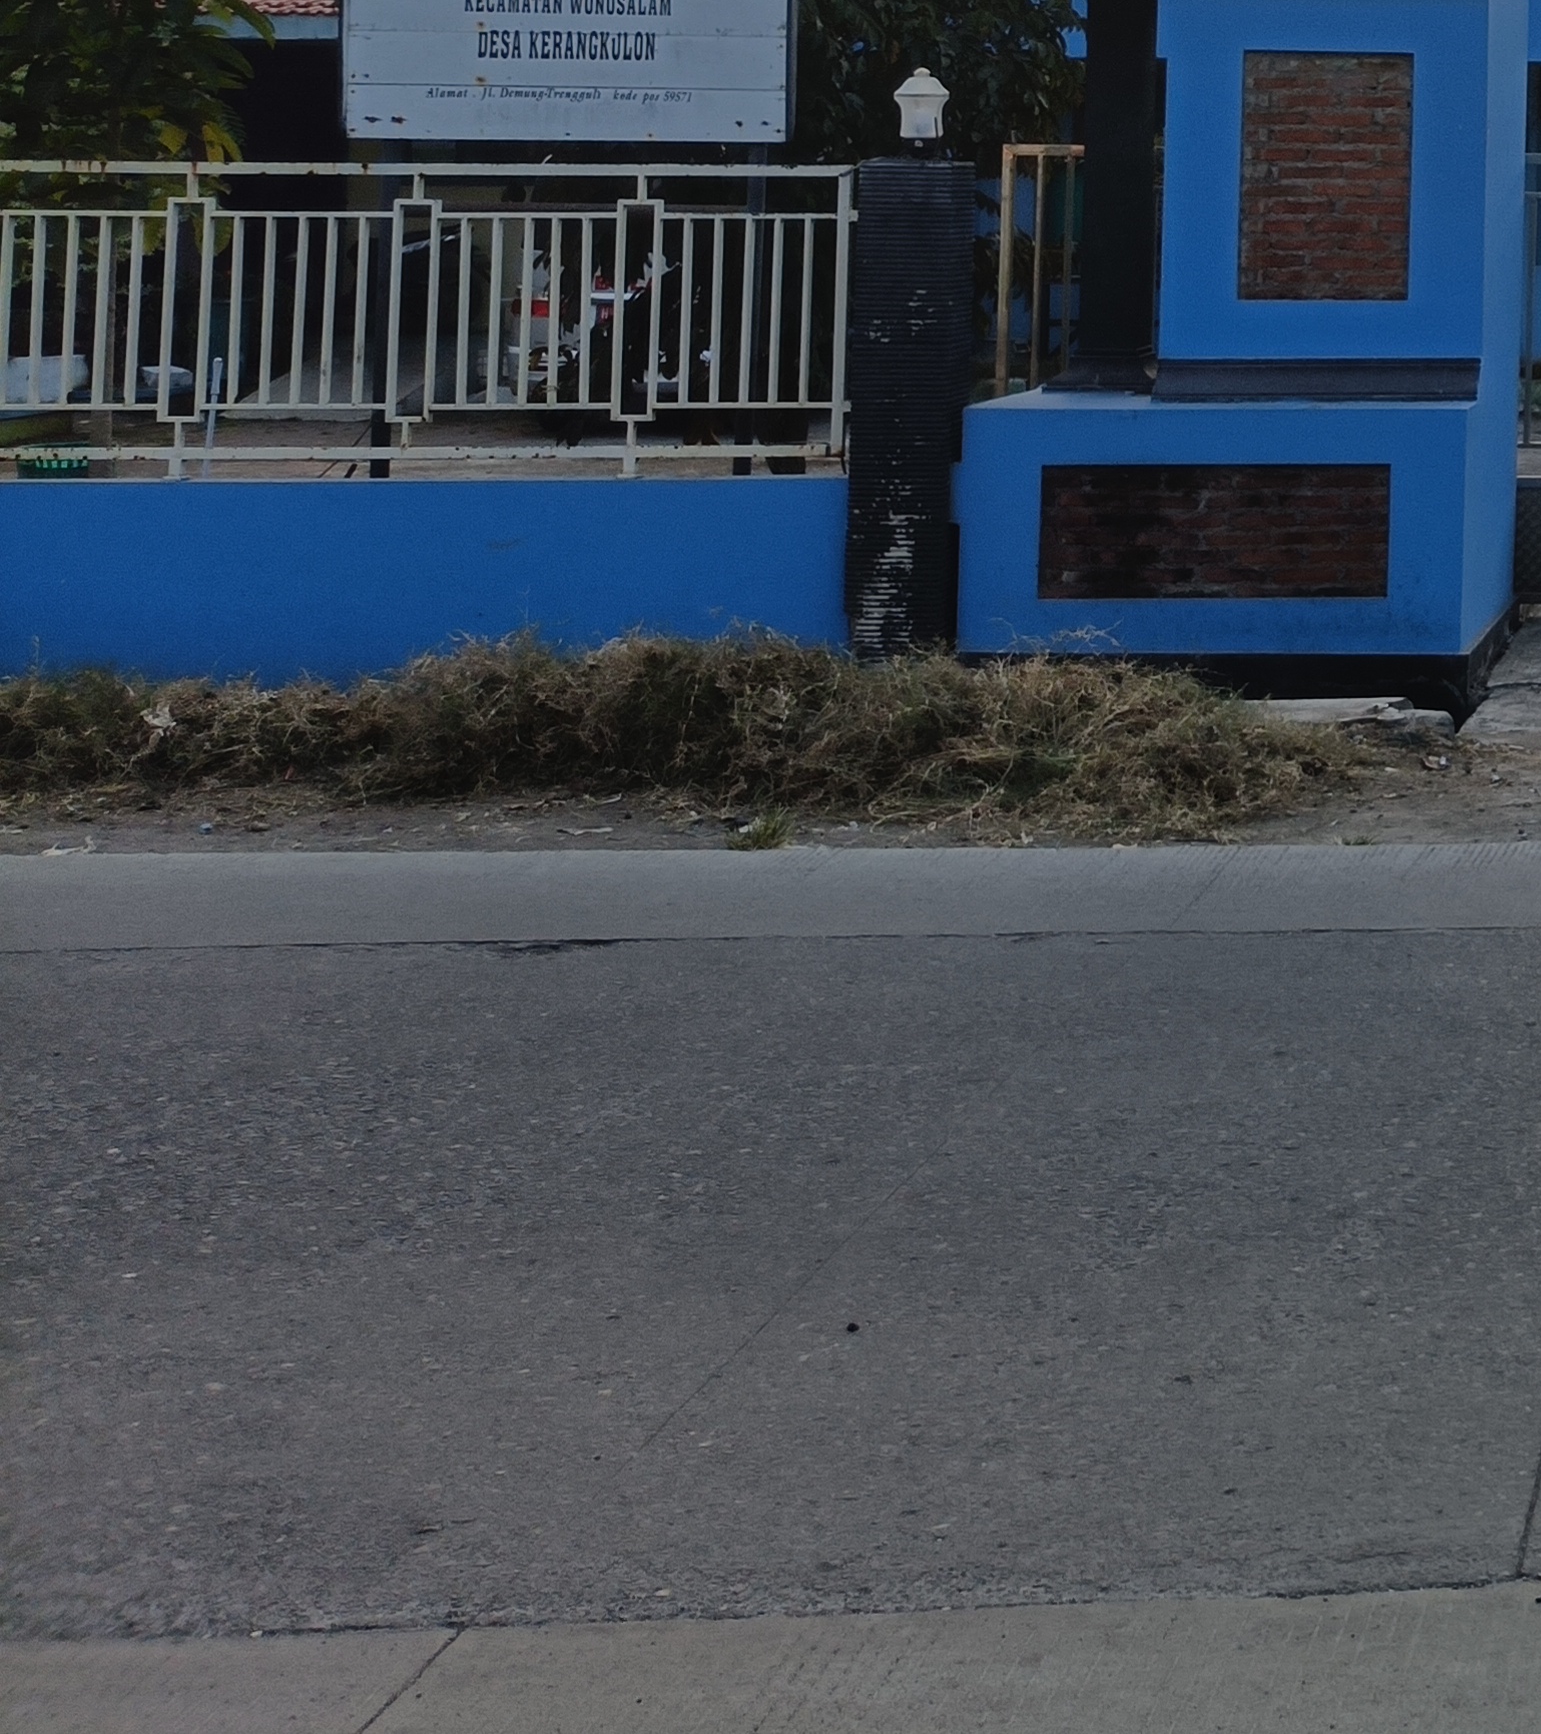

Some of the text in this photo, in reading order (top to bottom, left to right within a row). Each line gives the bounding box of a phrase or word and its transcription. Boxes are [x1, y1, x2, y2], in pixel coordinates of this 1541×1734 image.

[477, 29, 657, 62] DESA KERANGKULON
[425, 87, 468, 99] Alamat
[613, 89, 637, 101] kode
[641, 92, 660, 105] pos
[662, 91, 693, 103] 59571
